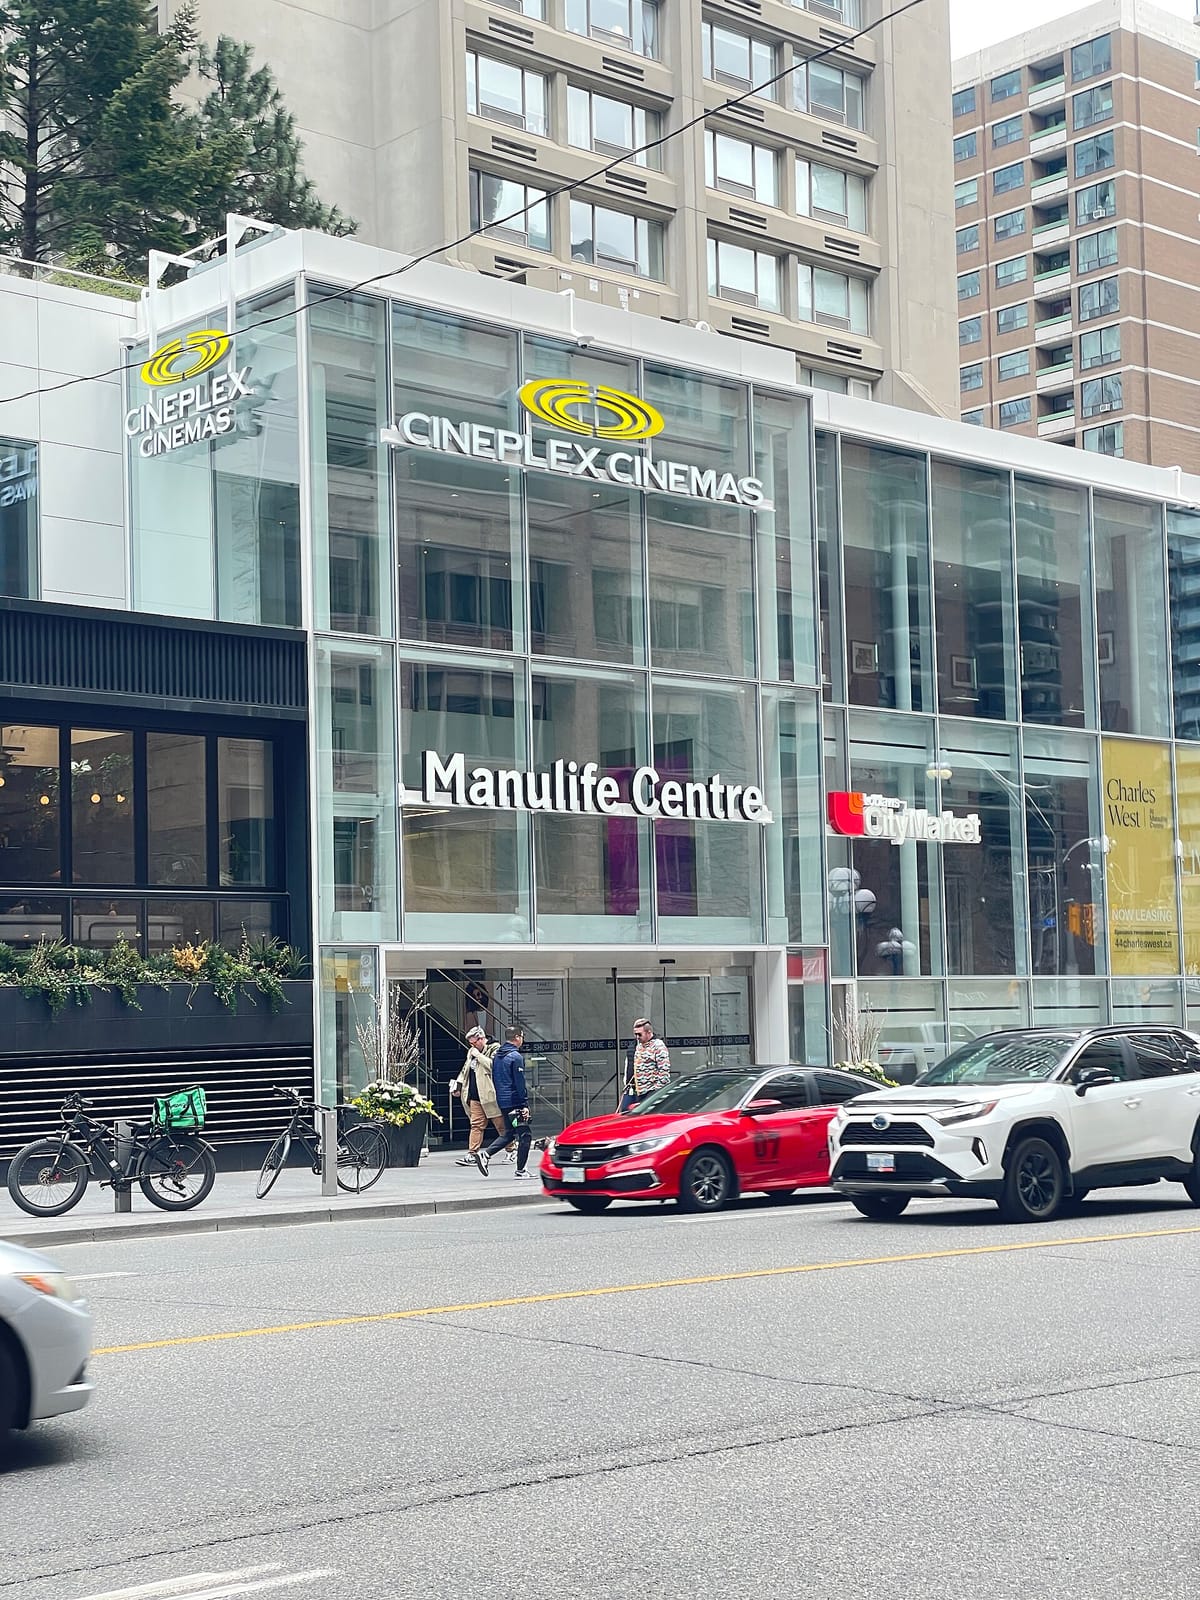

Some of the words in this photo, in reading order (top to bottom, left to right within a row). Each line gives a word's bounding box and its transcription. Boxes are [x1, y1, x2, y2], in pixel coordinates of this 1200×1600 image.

[124, 366, 253, 437] CINEPLEX
[139, 407, 235, 458] CINEMAS
[398, 411, 602, 479] CINEPLEX
[604, 453, 765, 507] CINEMAS
[422, 750, 620, 813] Manulife
[632, 765, 763, 820] Centre
[1106, 778, 1156, 804] Charles
[1108, 804, 1141, 828] West
[1112, 908, 1133, 921] NOW
[1136, 909, 1173, 922] LEASING
[1115, 938, 1172, 949] 44charleswest.ca
